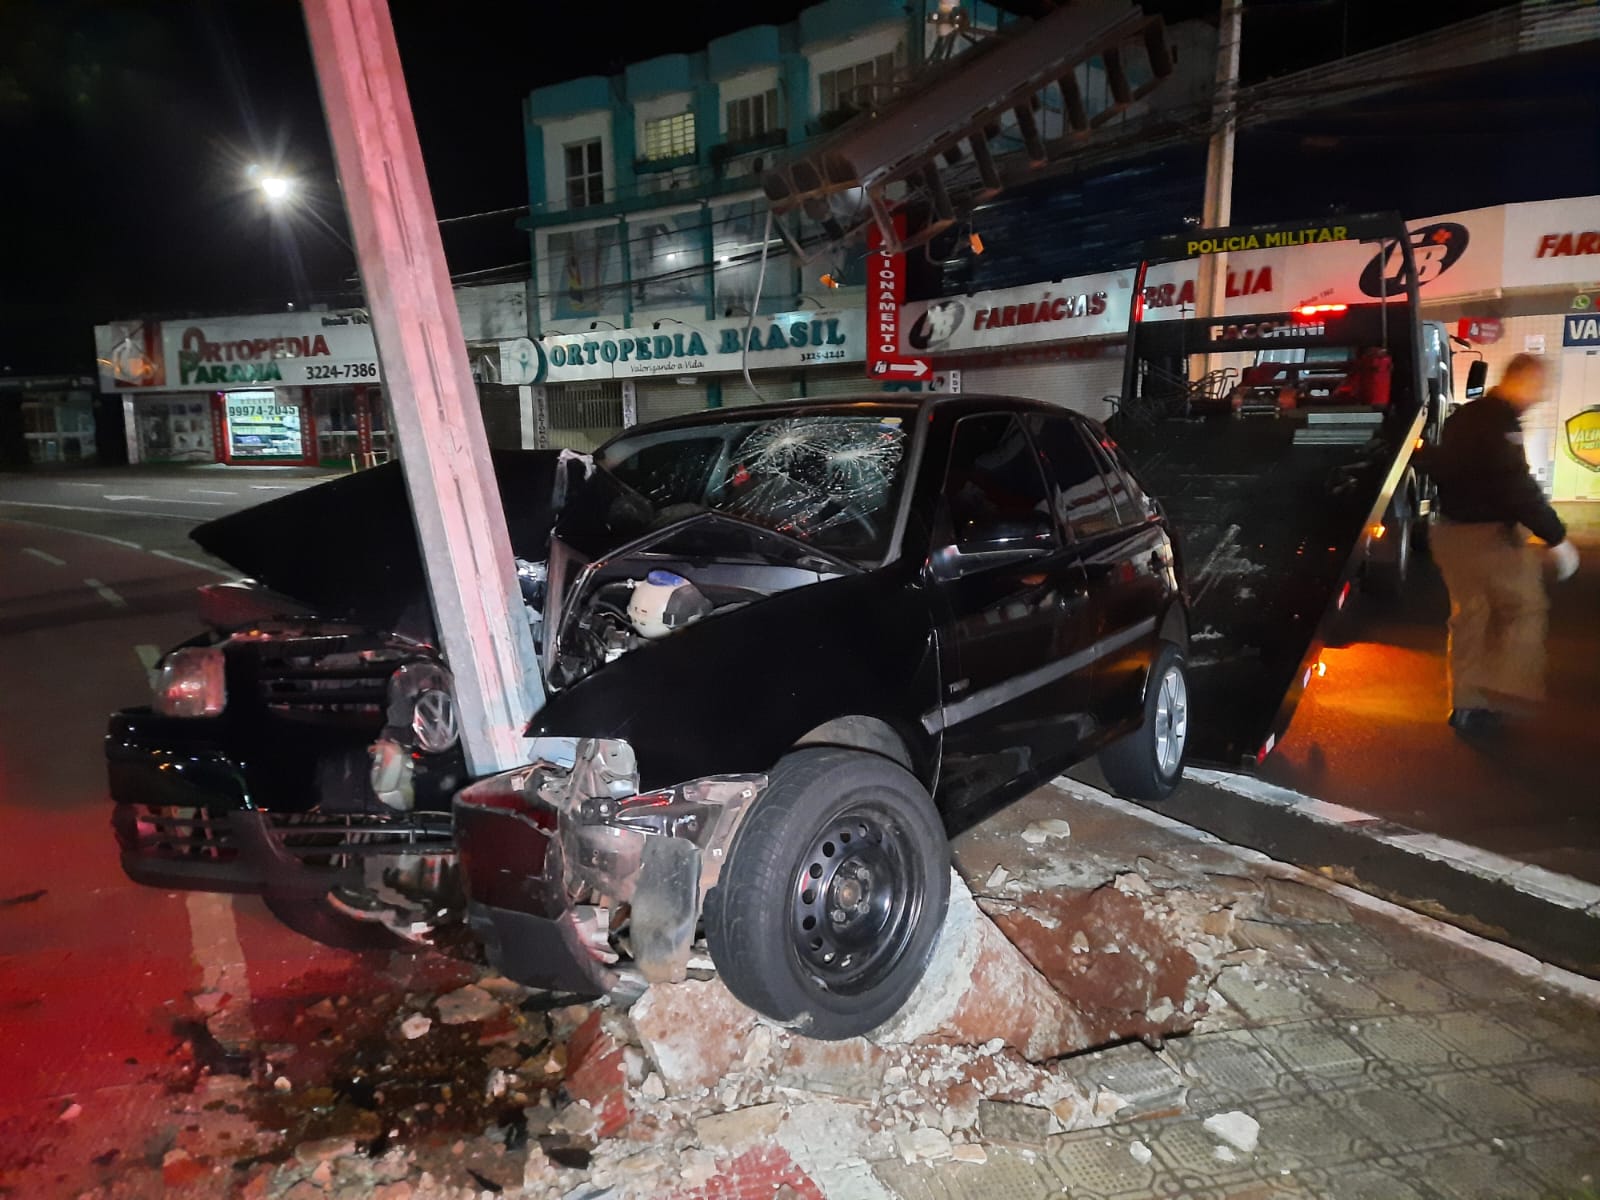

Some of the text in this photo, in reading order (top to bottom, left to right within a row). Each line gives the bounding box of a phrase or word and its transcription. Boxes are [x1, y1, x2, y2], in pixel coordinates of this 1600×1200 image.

[1265, 226, 1347, 247] MILITAR
[1535, 230, 1600, 258] FAR
[973, 292, 1107, 331] FARMÁCIAS
[182, 327, 330, 362] ORTOPEDIA
[550, 317, 846, 367] ORTOPEDIA BRASIL
[1210, 320, 1325, 341] FACCHINI
[306, 362, 376, 380] 3224-7386
